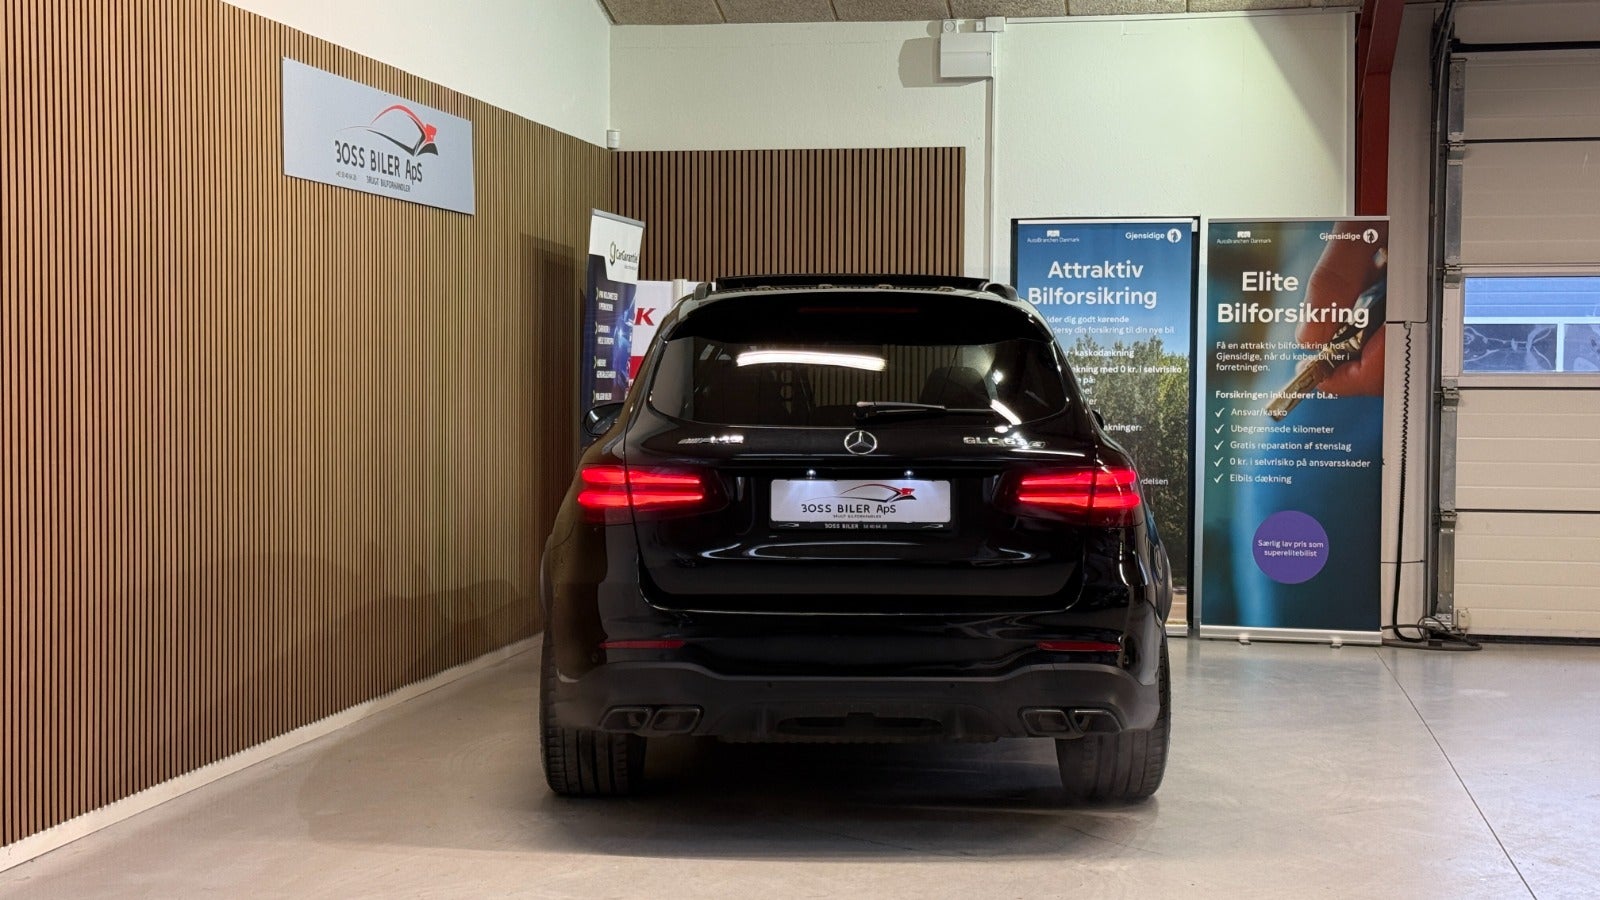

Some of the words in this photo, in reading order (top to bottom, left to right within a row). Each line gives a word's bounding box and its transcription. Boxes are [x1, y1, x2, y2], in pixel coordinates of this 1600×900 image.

[370, 149, 400, 177] BILER
[405, 159, 423, 186] ApS
[1125, 231, 1165, 242] Gjensidige
[1319, 231, 1361, 241] Gjensidige
[1047, 260, 1144, 279] Attraktiv
[1242, 270, 1299, 292] Elite
[1028, 286, 1158, 310] Bilforsikring
[634, 307, 656, 326] K
[1064, 315, 1077, 325] dig
[1077, 315, 1096, 325] godt
[1097, 315, 1130, 323] kørende
[1217, 302, 1370, 329] Bilforsikring
[1074, 326, 1087, 334] din
[1088, 325, 1124, 336] forsikring
[1125, 326, 1134, 334] til
[1135, 326, 1147, 334] din
[1149, 328, 1163, 336] nye
[1216, 340, 1227, 350] Få
[1240, 341, 1276, 350] attraktiv
[1277, 341, 1329, 352] bilforsikring
[1329, 342, 1346, 350] hos
[1074, 348, 1135, 359] kaskodækning
[1216, 352, 1263, 363] Gjensidige,
[1264, 351, 1278, 361] når
[1280, 352, 1291, 361] du
[1318, 352, 1329, 361] bil
[1331, 352, 1345, 361] her
[1100, 365, 1119, 374] med
[1120, 365, 1126, 373] 0
[1127, 365, 1137, 373] kr.
[1143, 365, 1183, 374] selvrisiko
[1216, 363, 1271, 373] forretningen.
[1215, 390, 1269, 401] Forsikringen
[1270, 391, 1315, 400] inkluderer
[1230, 408, 1288, 418] Ansvar/kasko
[1230, 425, 1291, 435] Ubegrænsede
[1292, 425, 1335, 434] kilometer
[1229, 441, 1256, 450] Gratis
[1257, 441, 1302, 452] reparation
[1304, 441, 1313, 450] af
[1314, 442, 1352, 453] stenslag
[1229, 458, 1236, 466] 0
[1237, 457, 1248, 466] kr.
[1254, 458, 1295, 467] selvrisiko
[1296, 458, 1307, 468] på
[1308, 459, 1371, 468] ansvarsskader
[1254, 474, 1292, 485] dækning
[837, 504, 871, 513] BILER
[876, 504, 897, 515] ApS
[1257, 539, 1281, 549] Særlig
[1281, 540, 1293, 548] lav
[1293, 540, 1307, 549] pris
[1308, 541, 1324, 549] som
[1263, 549, 1318, 558] superelitebilist
